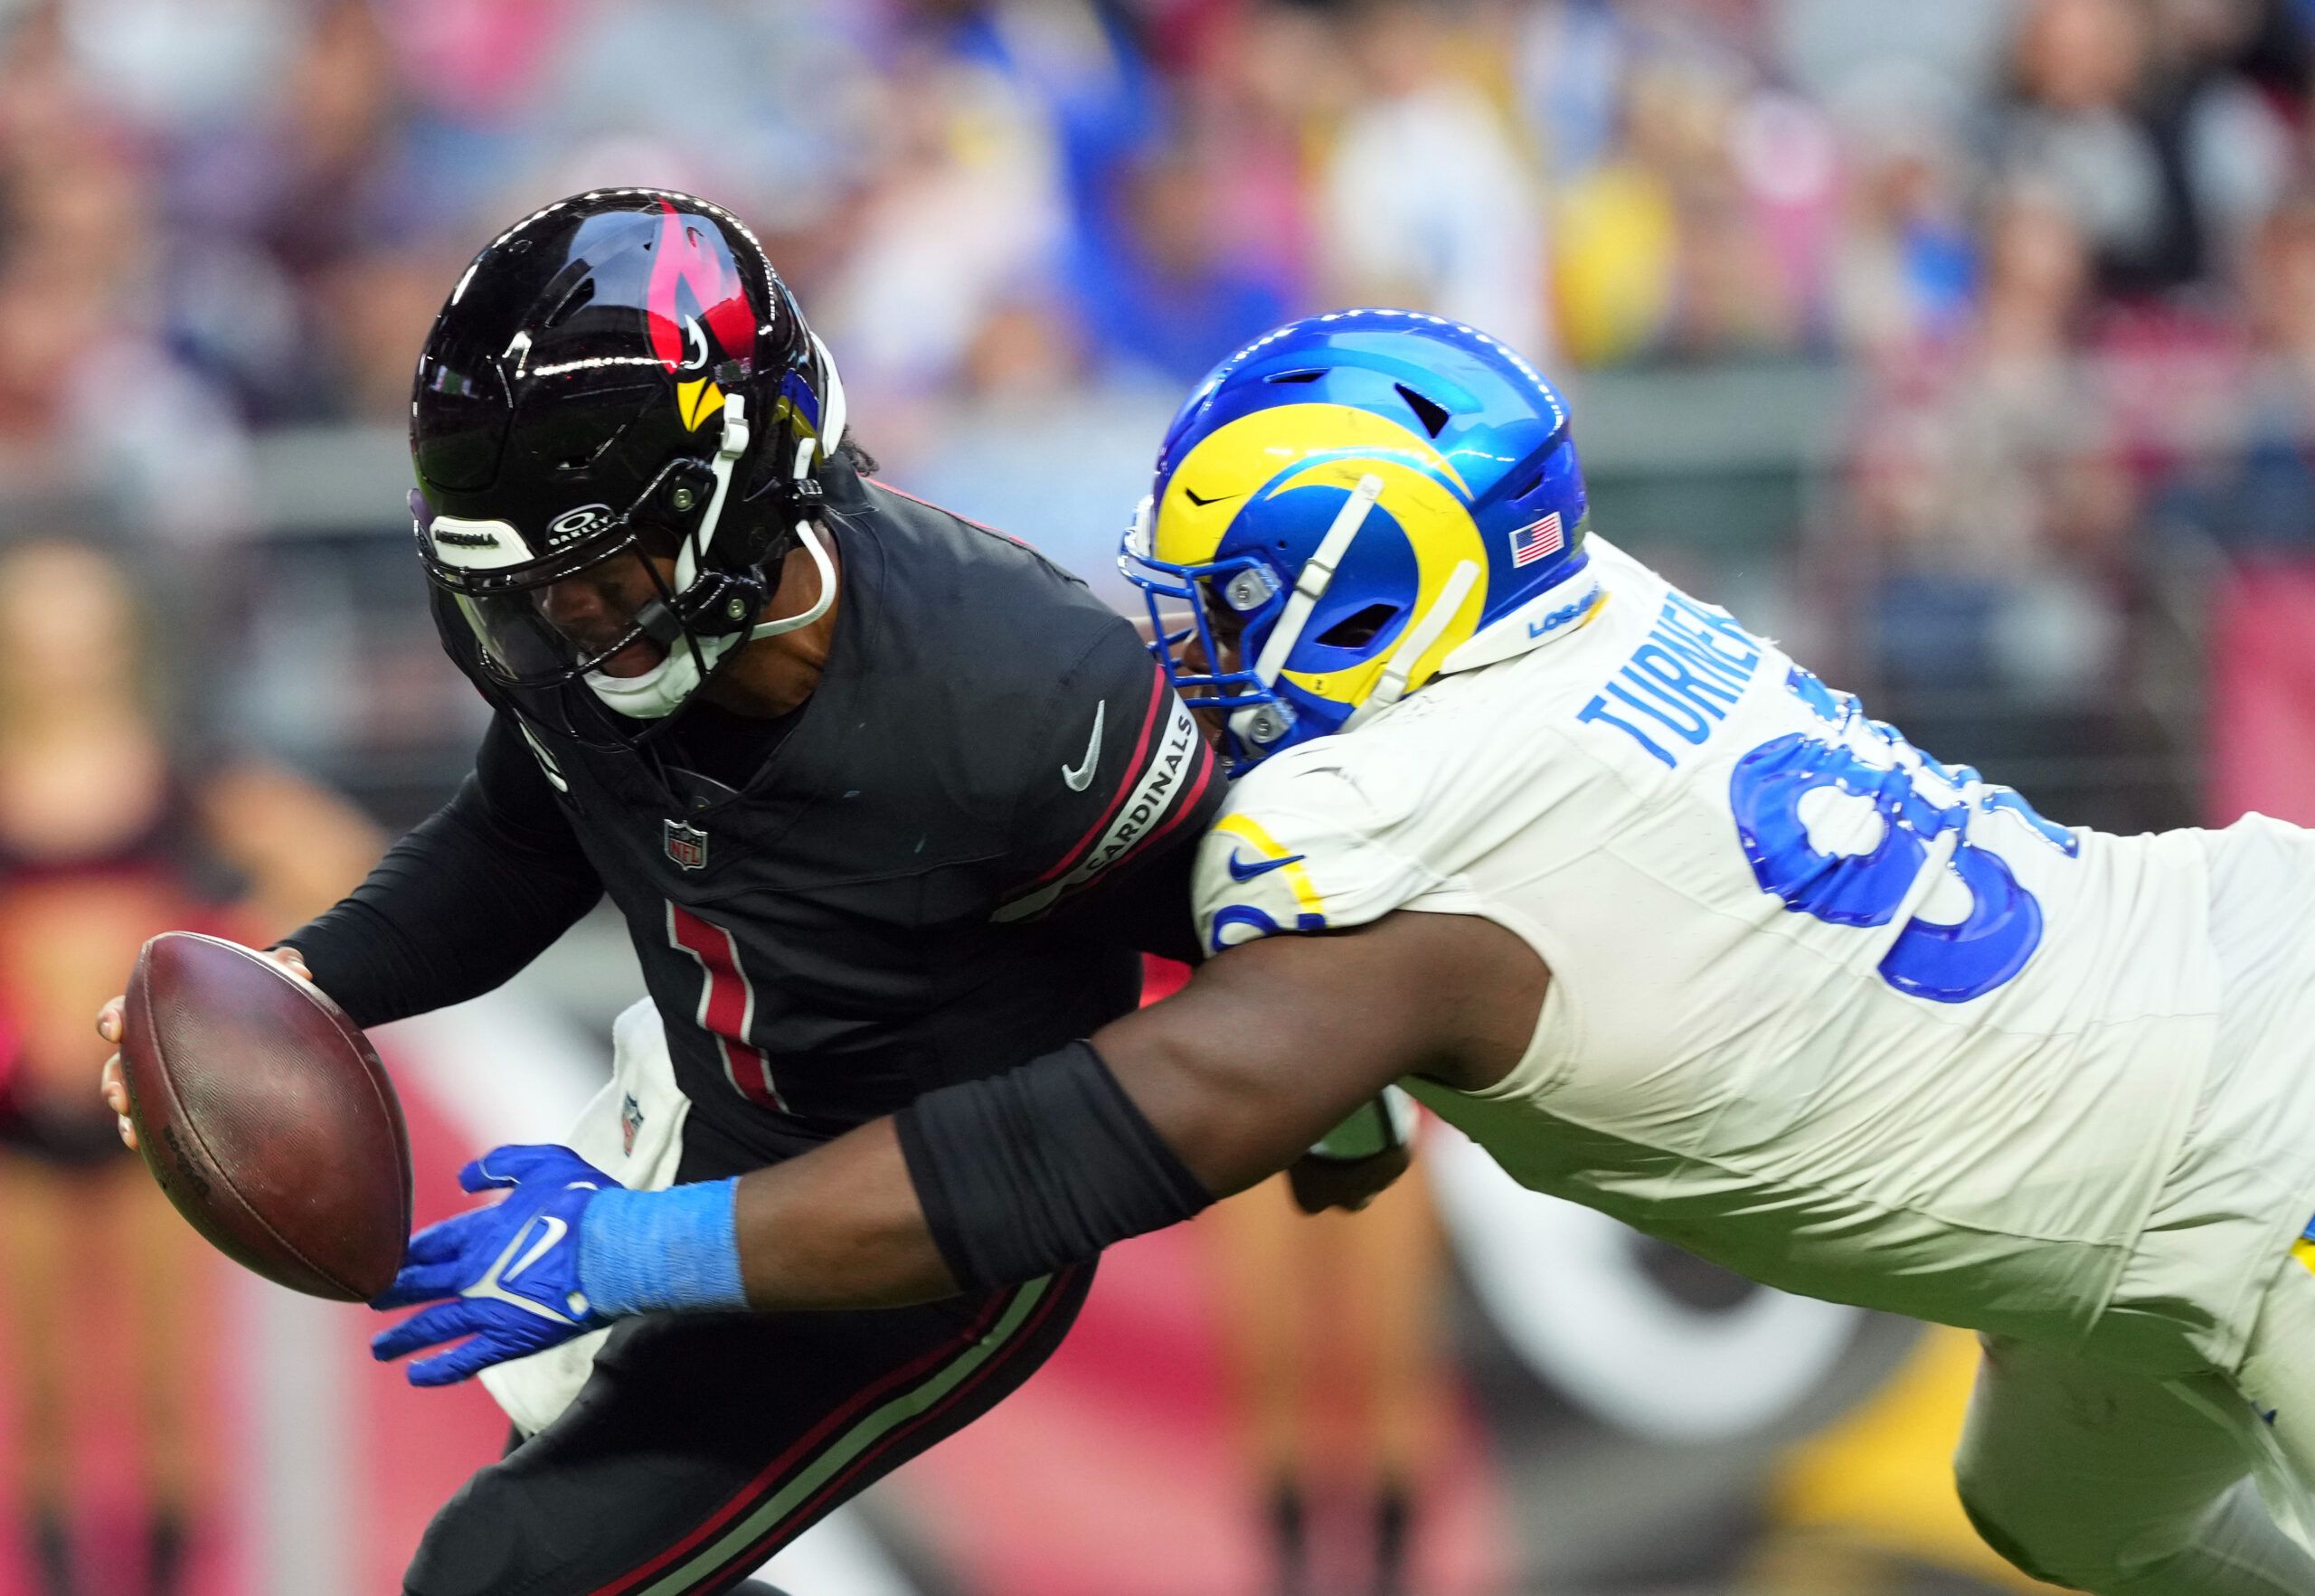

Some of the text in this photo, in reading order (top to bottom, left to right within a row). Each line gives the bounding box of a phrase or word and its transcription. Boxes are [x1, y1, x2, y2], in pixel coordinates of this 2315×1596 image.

[548, 516, 609, 546] OAKLEY
[1576, 592, 1762, 770] TURNER
[668, 839, 703, 865] NFL
[1086, 714, 1194, 871] CARDINALS
[665, 898, 790, 1115] 1
